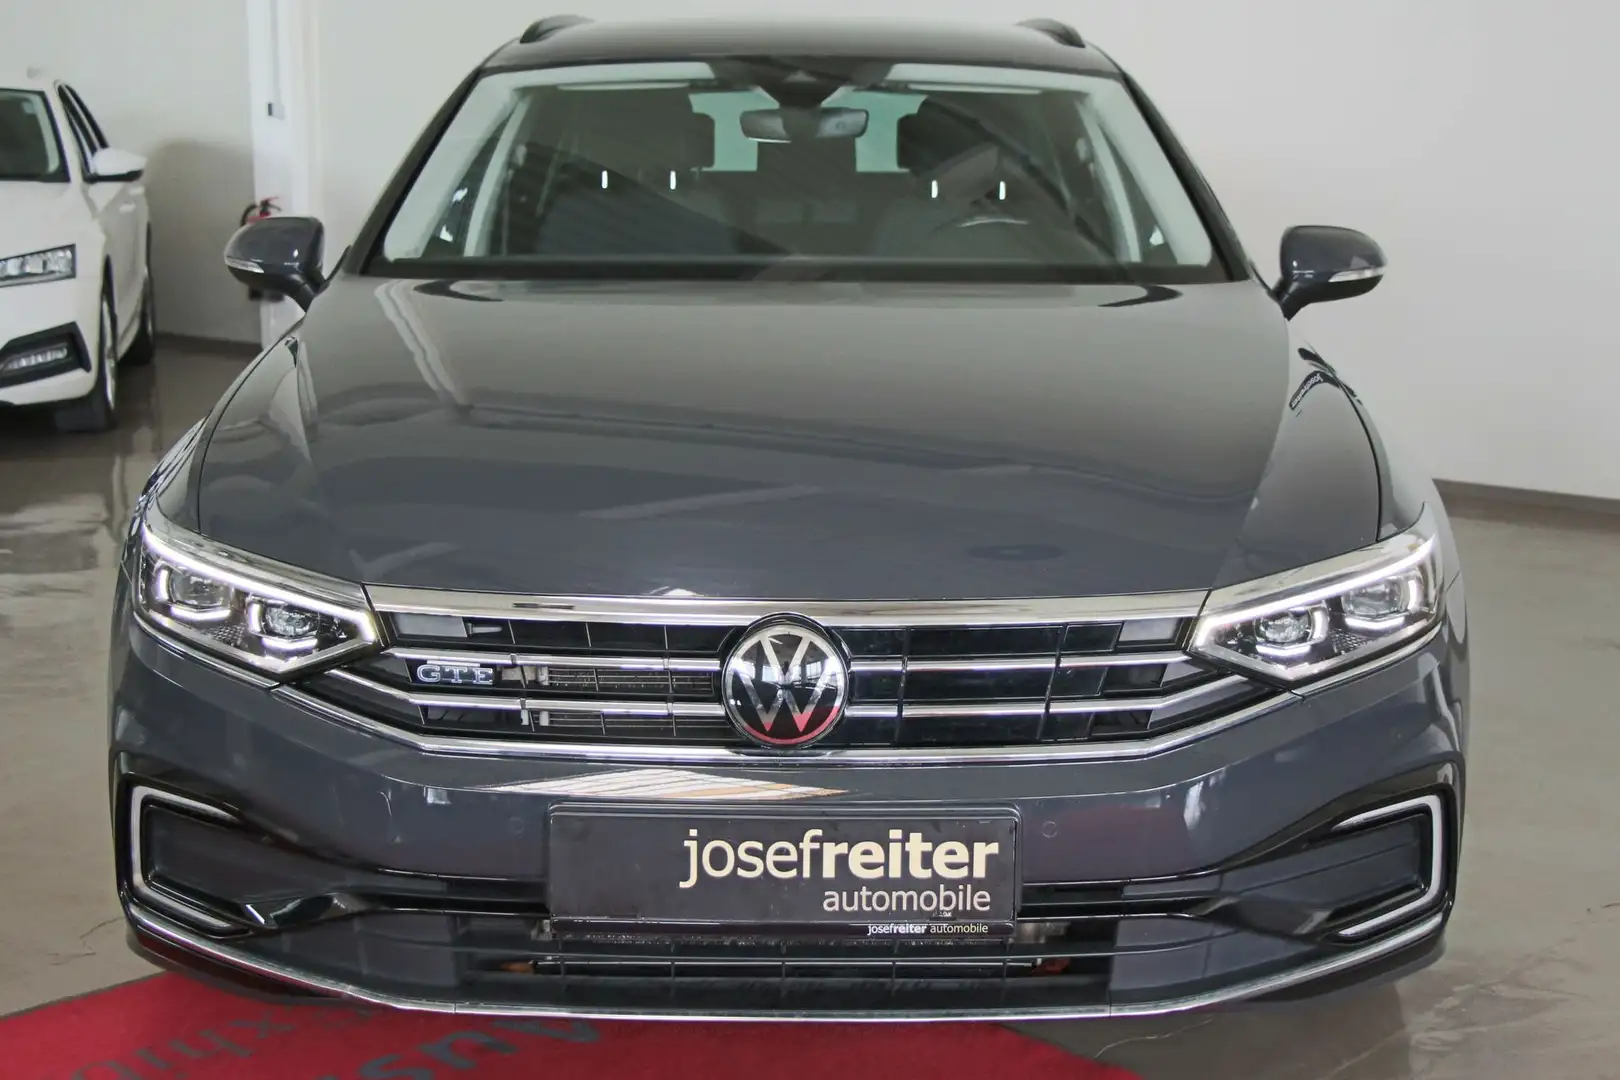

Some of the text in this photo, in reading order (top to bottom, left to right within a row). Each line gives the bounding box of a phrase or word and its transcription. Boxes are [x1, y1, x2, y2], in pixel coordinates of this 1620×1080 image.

[416, 664, 493, 685] GTE
[727, 624, 845, 744] VW
[679, 828, 999, 889] josefreiter
[823, 884, 991, 912] automobile
[867, 922, 989, 936] josefreiter automobile
